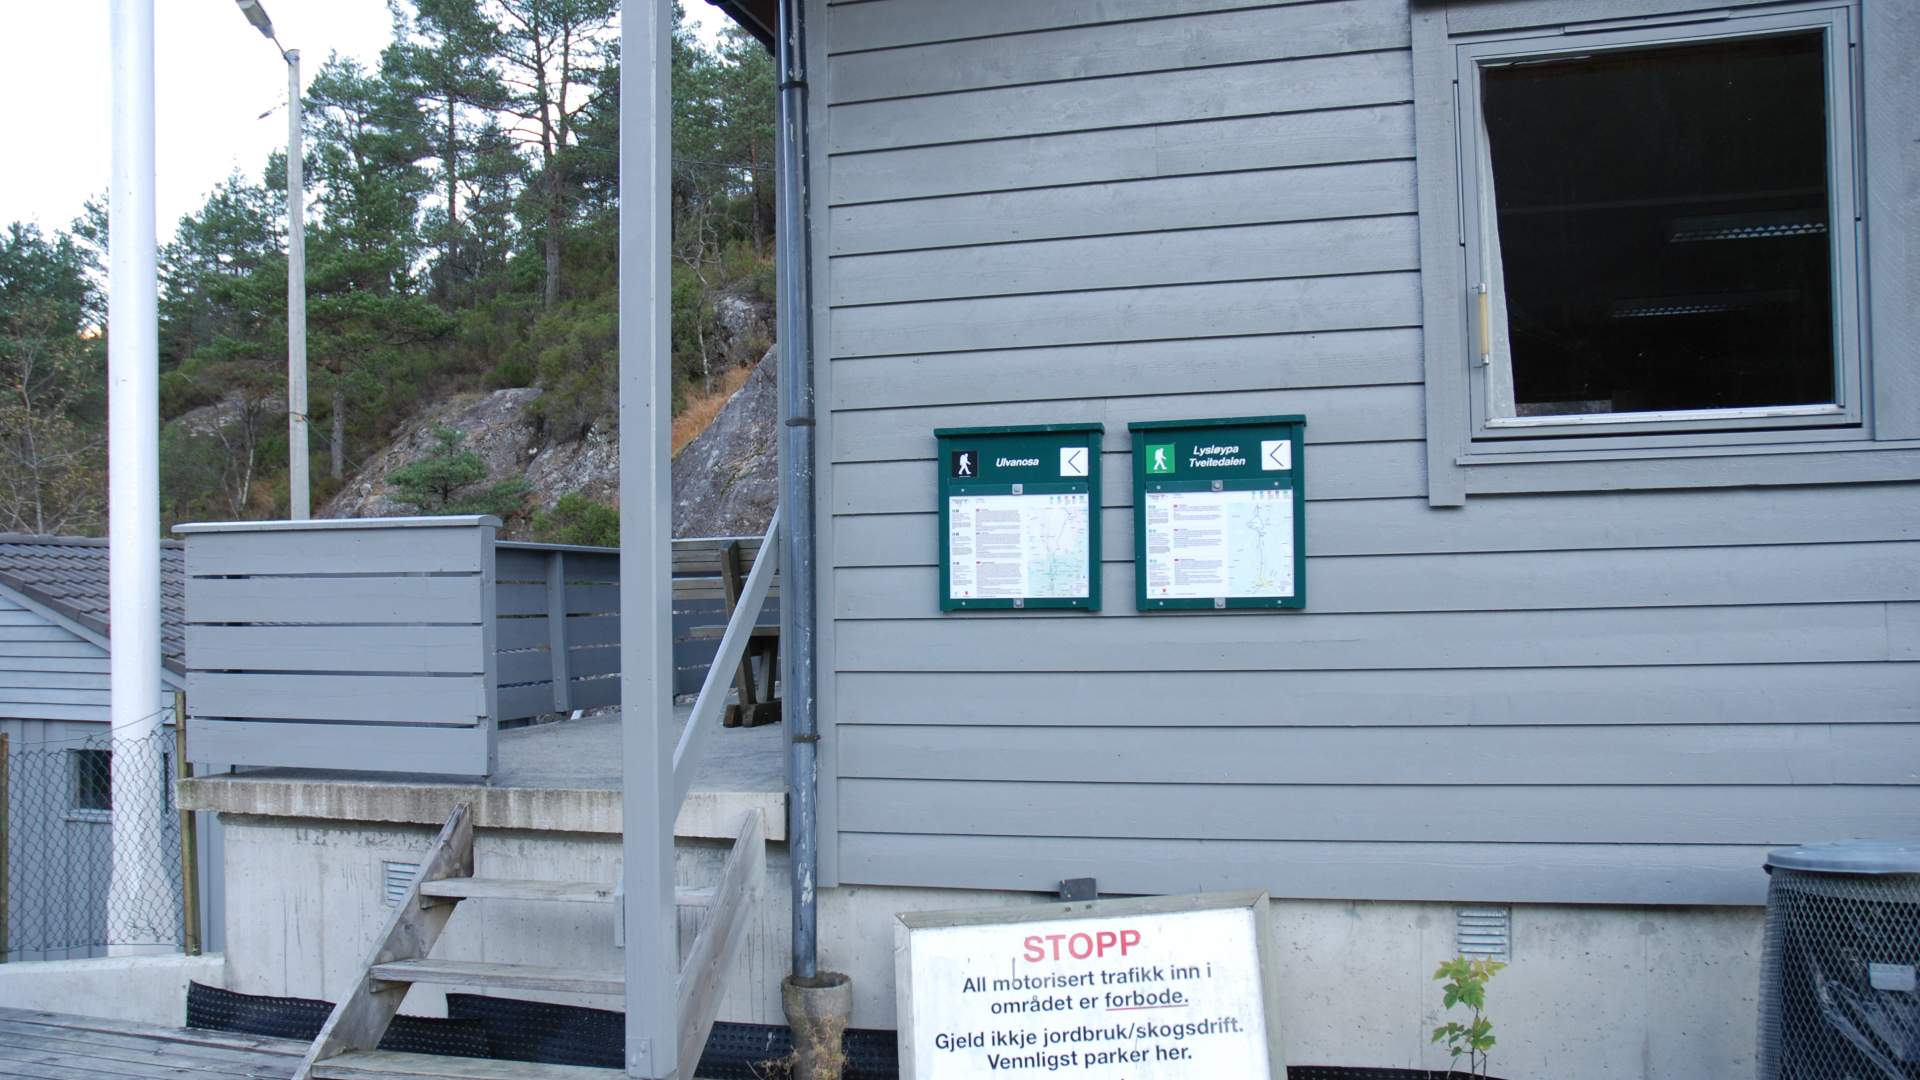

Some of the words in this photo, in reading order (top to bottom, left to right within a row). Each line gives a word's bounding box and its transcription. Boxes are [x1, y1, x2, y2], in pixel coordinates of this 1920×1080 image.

[995, 457, 1040, 468] Ulvanosa
[1189, 456, 1246, 468] Tveitedalen
[1193, 445, 1239, 457] Lysløypa
[1023, 929, 1142, 963] STOPP
[963, 977, 986, 993] All
[994, 971, 1095, 992] motorisert
[1101, 967, 1164, 985] trafikk
[1171, 965, 1200, 980] inn
[1206, 962, 1212, 978] i
[991, 995, 1073, 1015] området
[1079, 996, 1099, 1009] er
[1105, 988, 1189, 1008] forbode.
[935, 1031, 985, 1052] Gjeld
[991, 1028, 1037, 1048] ikkje
[1043, 1017, 1244, 1047] jordbruk/skogsdrift.
[988, 1051, 1077, 1071] Vennligst
[1084, 1048, 1149, 1068] parker
[1156, 1045, 1192, 1060] her.
